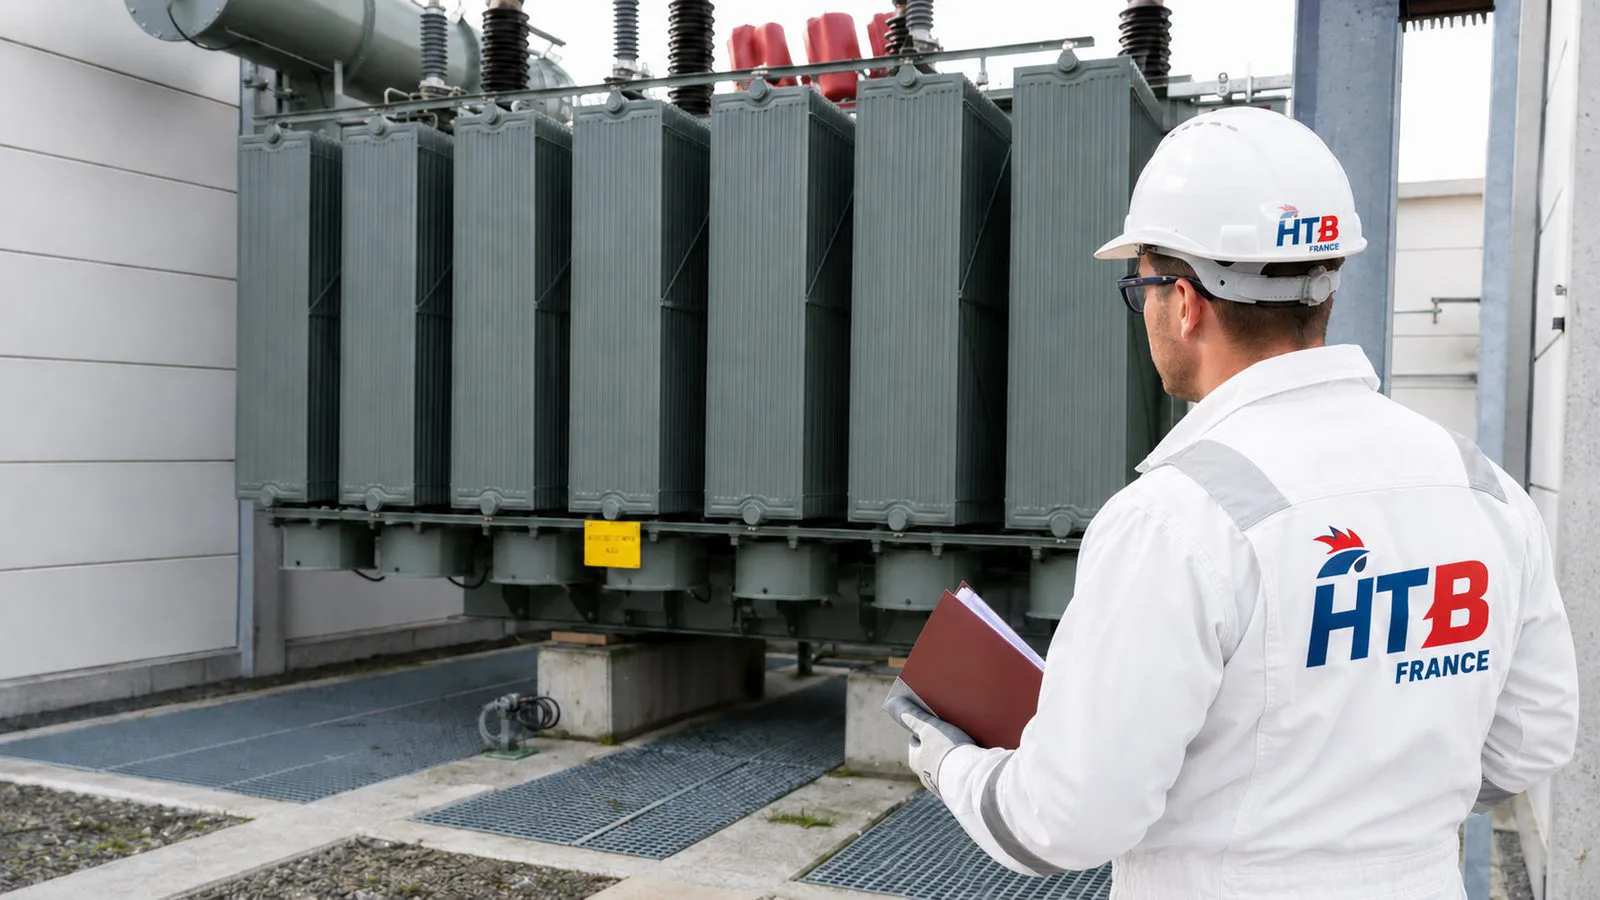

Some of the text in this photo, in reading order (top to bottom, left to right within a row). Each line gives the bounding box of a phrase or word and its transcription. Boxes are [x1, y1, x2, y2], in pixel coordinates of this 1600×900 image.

[1276, 215, 1339, 247] HTB
[1309, 243, 1340, 253] FRANCE
[1306, 560, 1489, 668] HTB
[1395, 650, 1490, 684] FRANCE
